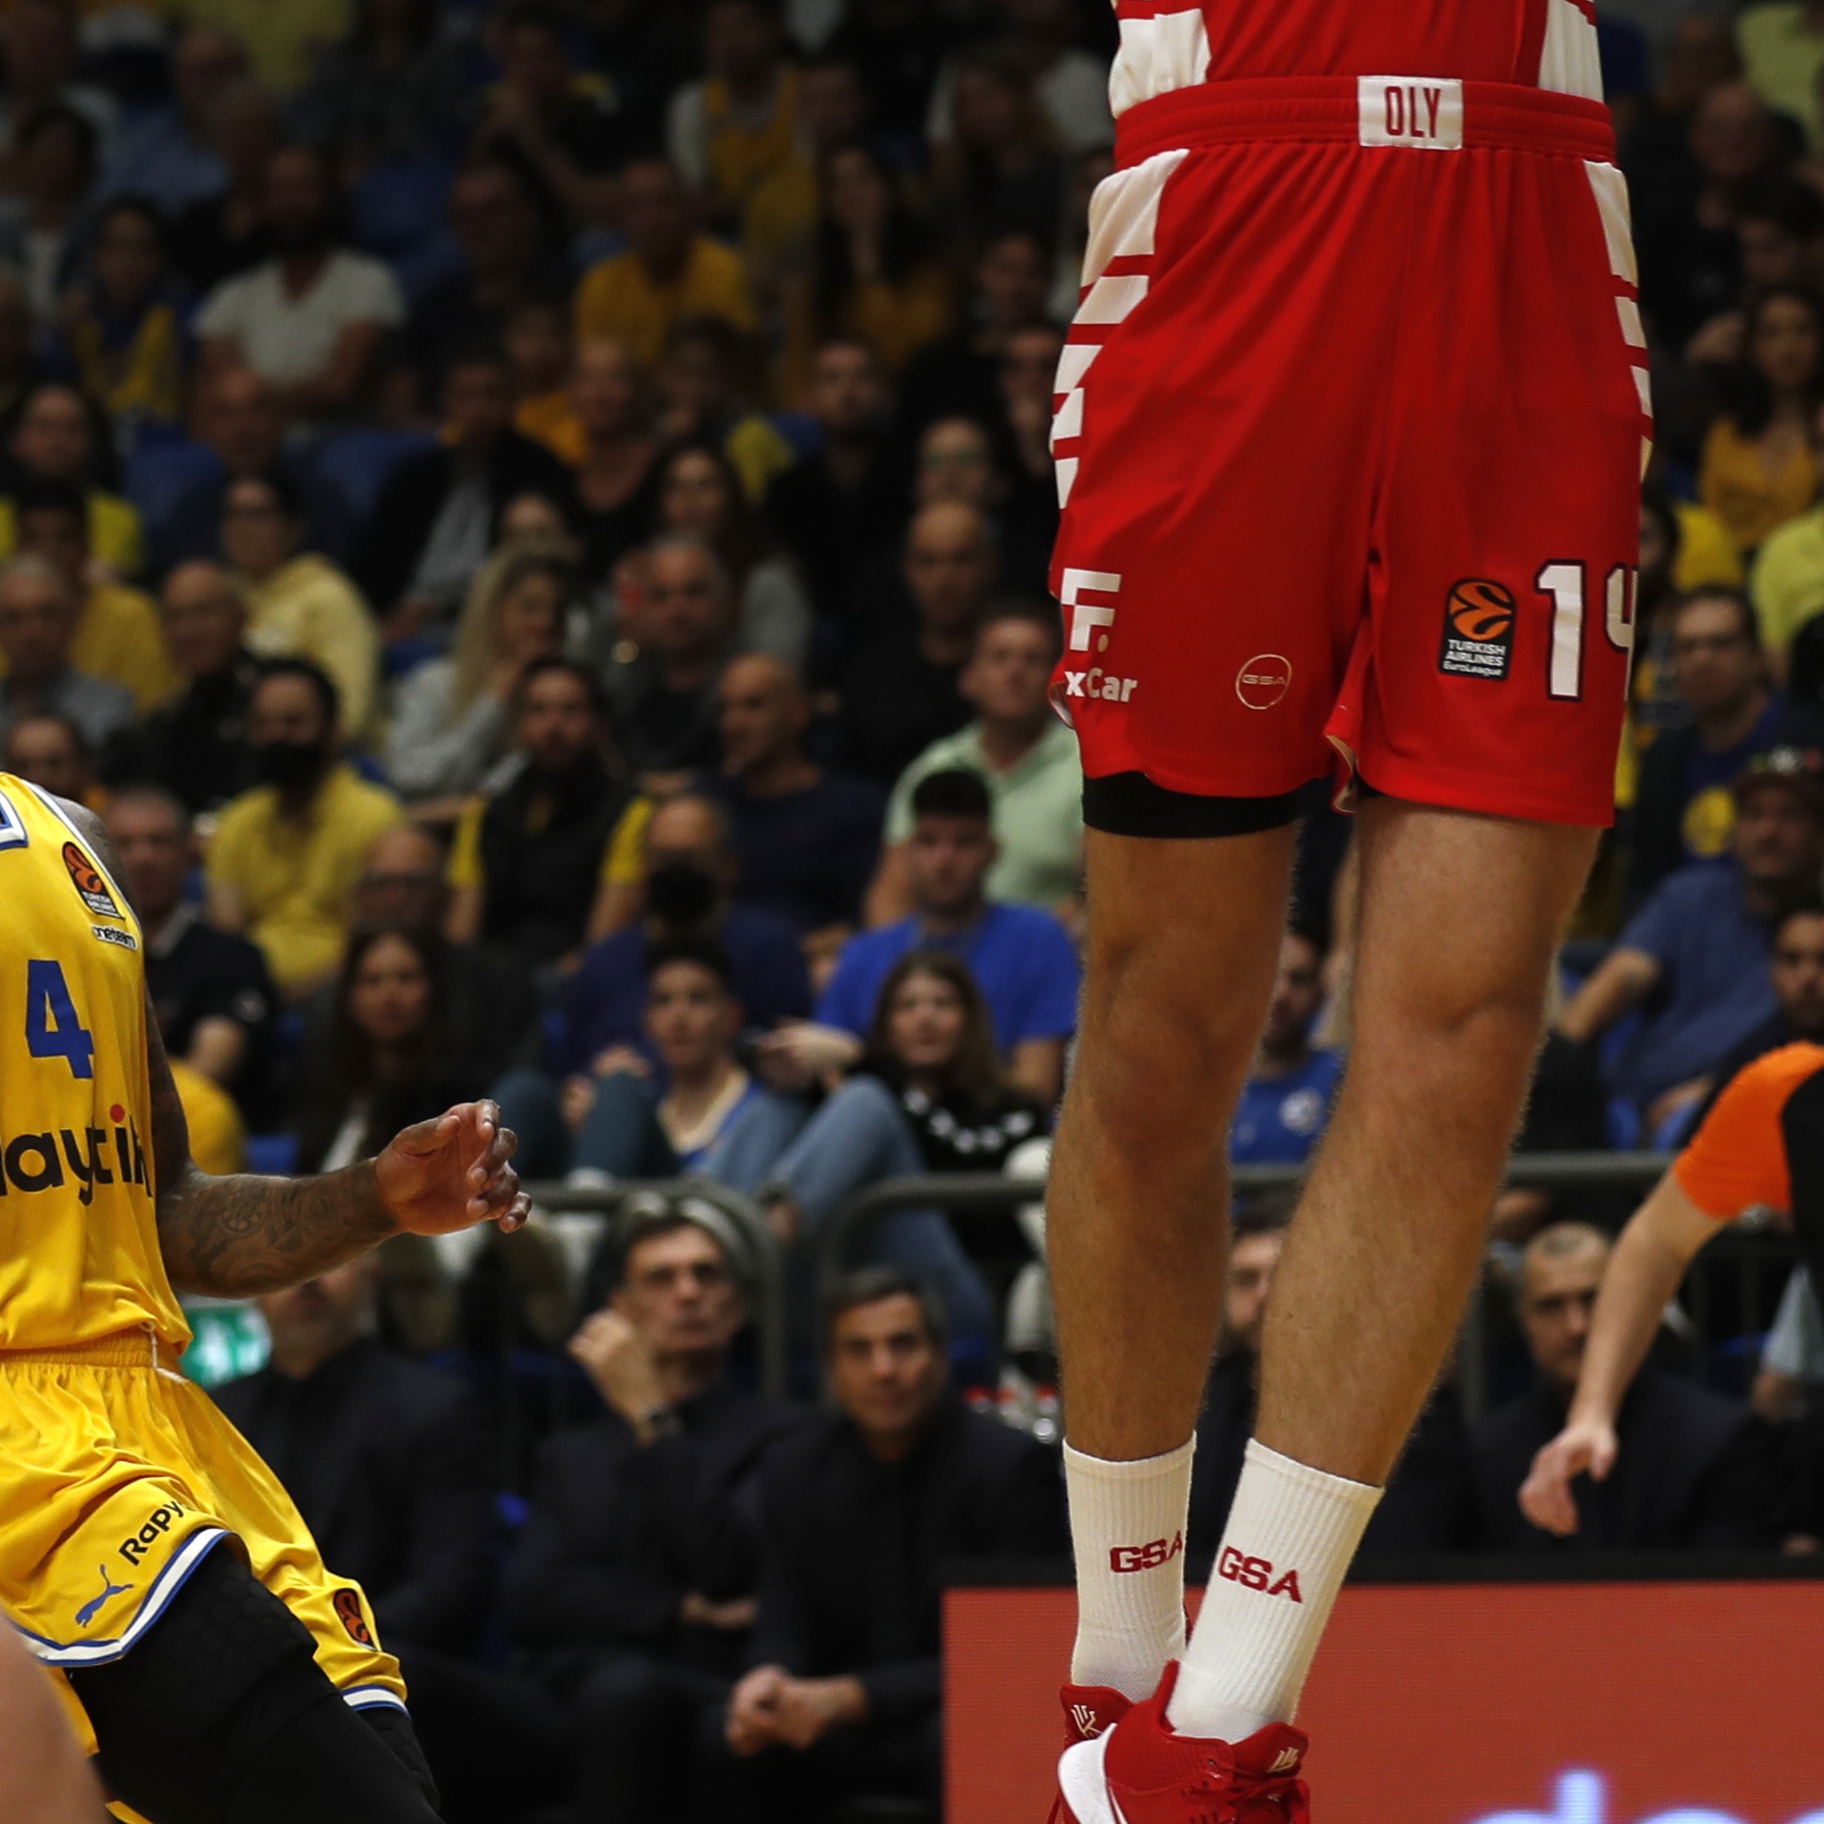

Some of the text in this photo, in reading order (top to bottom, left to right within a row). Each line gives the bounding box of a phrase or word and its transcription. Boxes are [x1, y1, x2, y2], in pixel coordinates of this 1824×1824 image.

[1385, 84, 1442, 141] OLY
[1445, 650, 1505, 667] AIRLINES
[1448, 639, 1507, 656] TURKISH
[1064, 667, 1138, 704] xCar
[26, 959, 95, 1079] 4
[118, 1500, 185, 1567] Rapy
[1109, 1530, 1183, 1573] GSA
[1218, 1545, 1303, 1603] GSA
